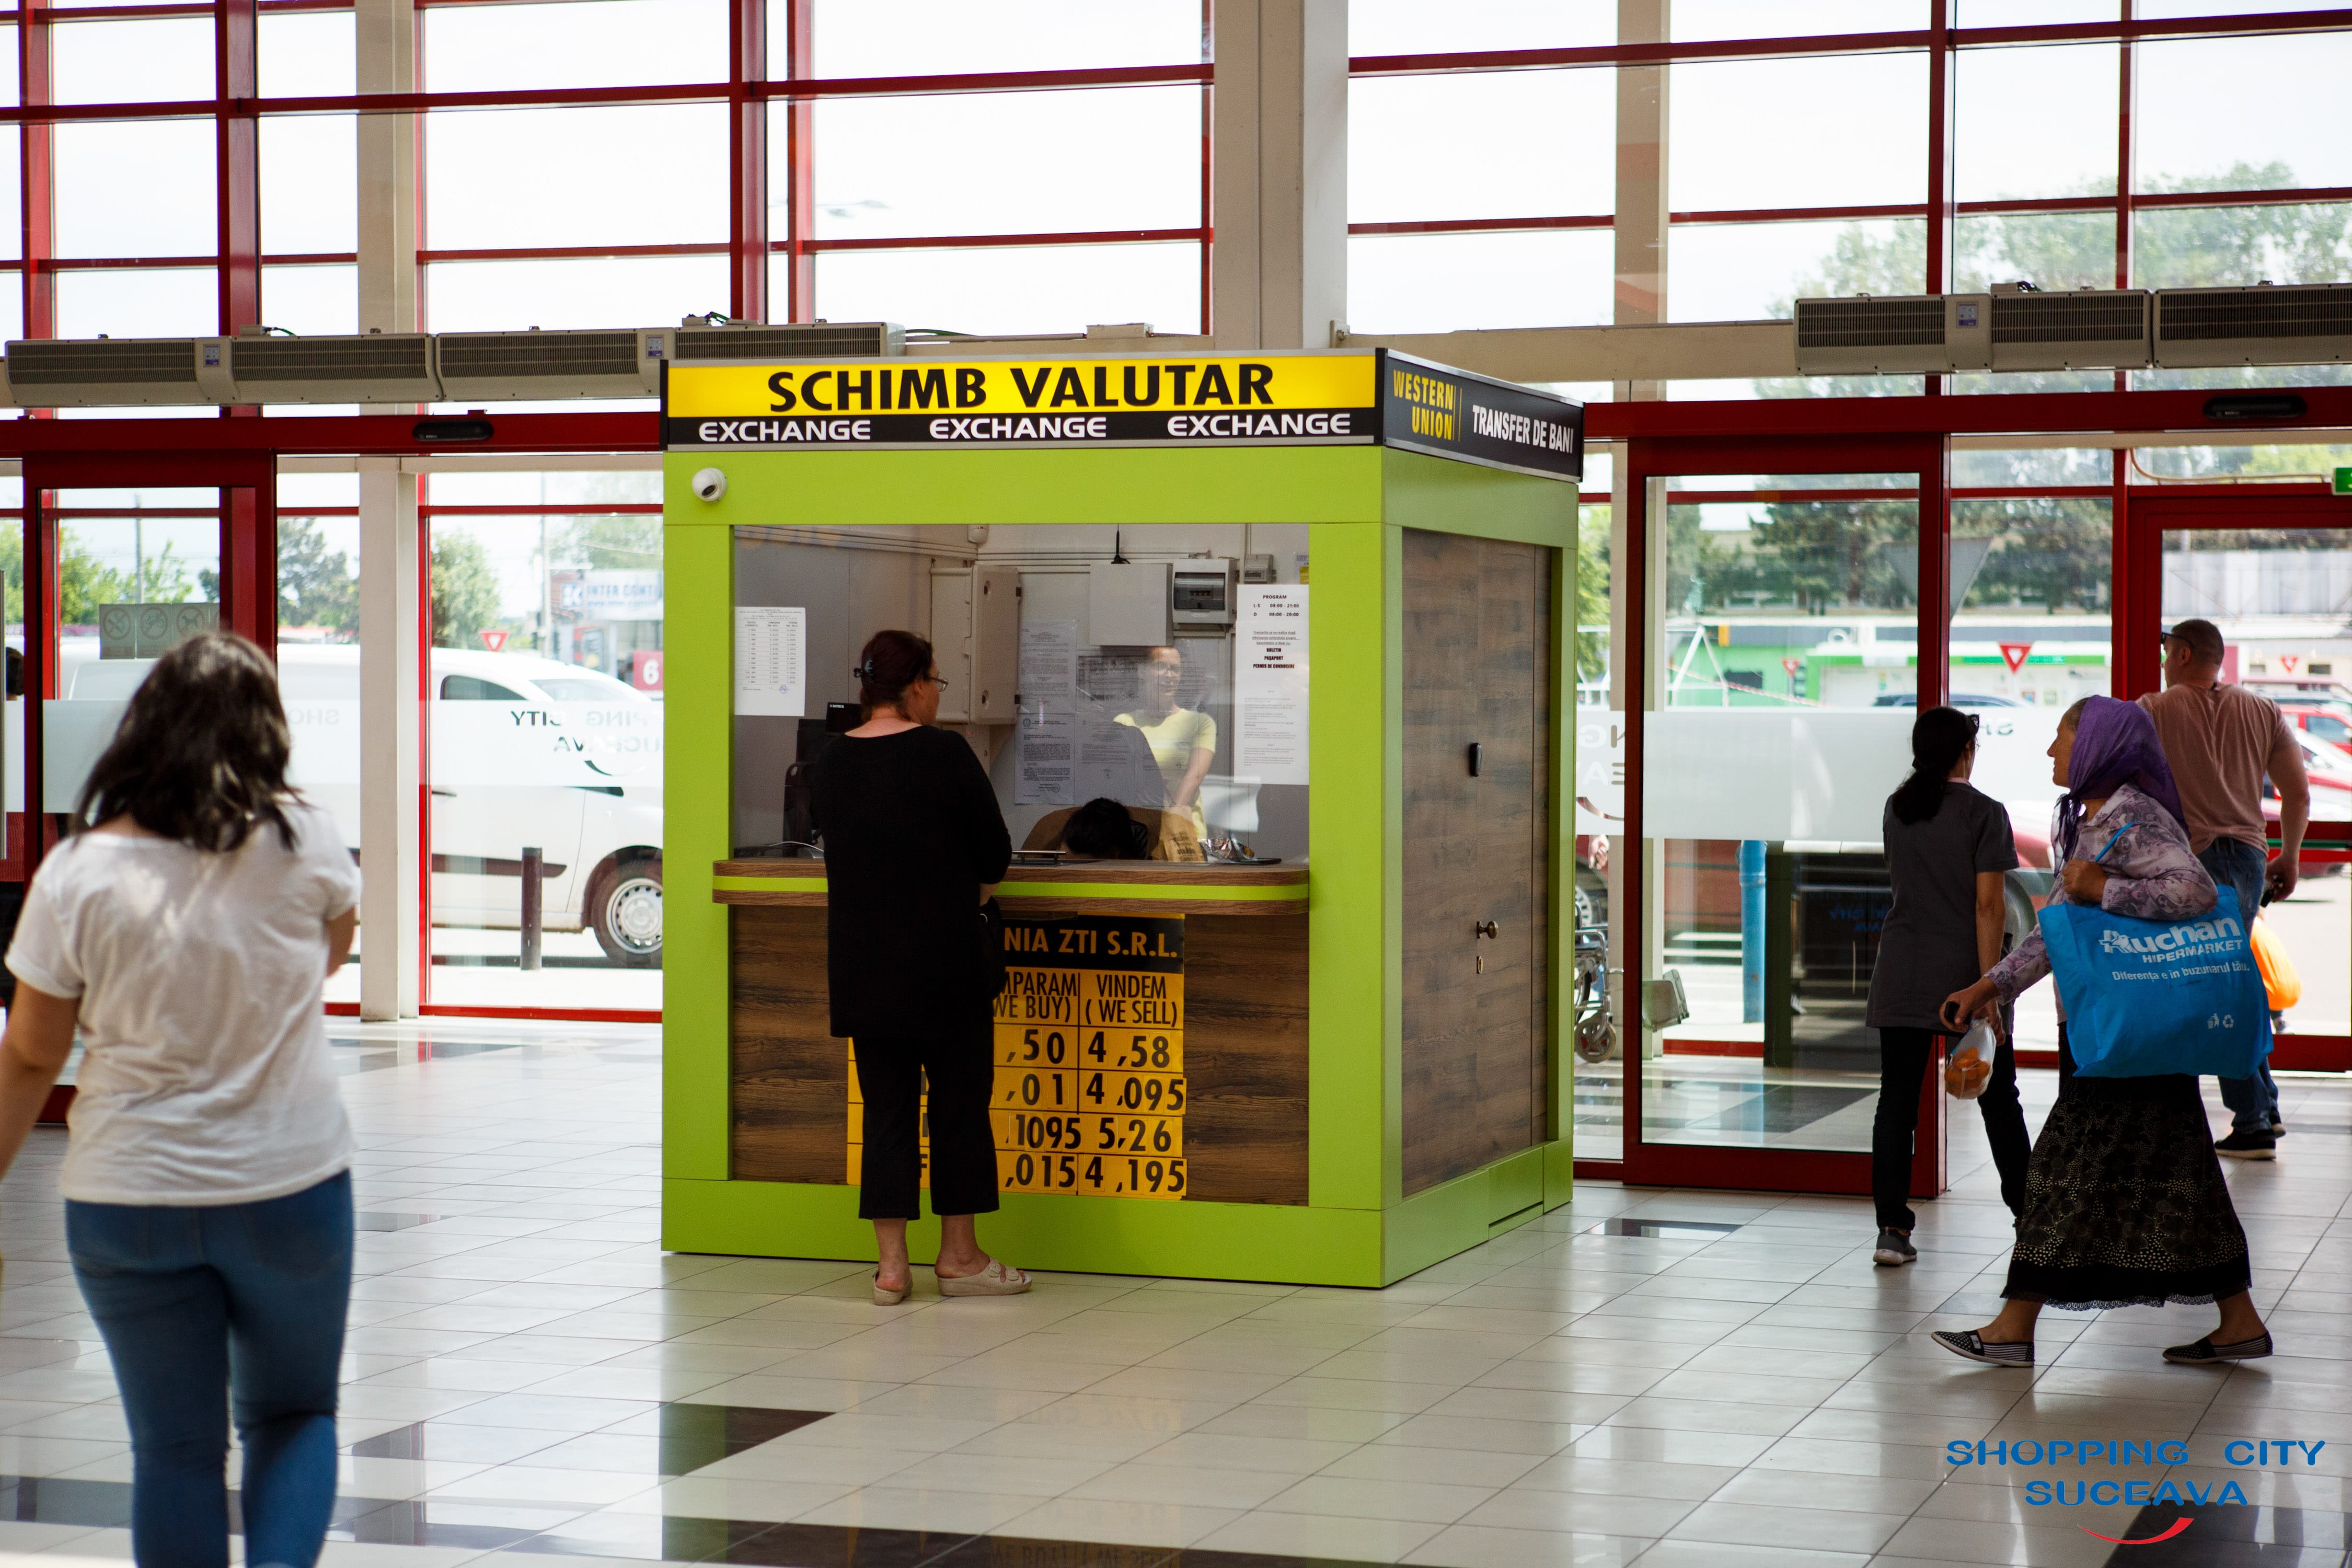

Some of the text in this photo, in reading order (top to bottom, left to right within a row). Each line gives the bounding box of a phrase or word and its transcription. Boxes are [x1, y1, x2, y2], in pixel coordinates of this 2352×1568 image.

[768, 363, 1274, 412] SCHIMB VALUTAR
[1393, 370, 1454, 411] WESTERN
[699, 420, 871, 443] EXCHANGE
[929, 416, 1107, 440] EXCHANGE
[1167, 413, 1351, 437] EXCHANGE
[1412, 406, 1452, 441] UNION
[1472, 405, 1574, 454] TRANSFER DE BANI
[643, 659, 660, 685] 6
[1058, 929, 1097, 954] ZTI
[1107, 930, 1178, 958] S.R.L.
[2099, 917, 2241, 954] Auchan
[2142, 939, 2243, 963] HIPERMARKET
[2183, 963, 2230, 977] buzunarul
[1096, 974, 1167, 999] VINDEM
[1025, 996, 1071, 1023] BUY)
[1132, 1000, 1178, 1028] SELL)
